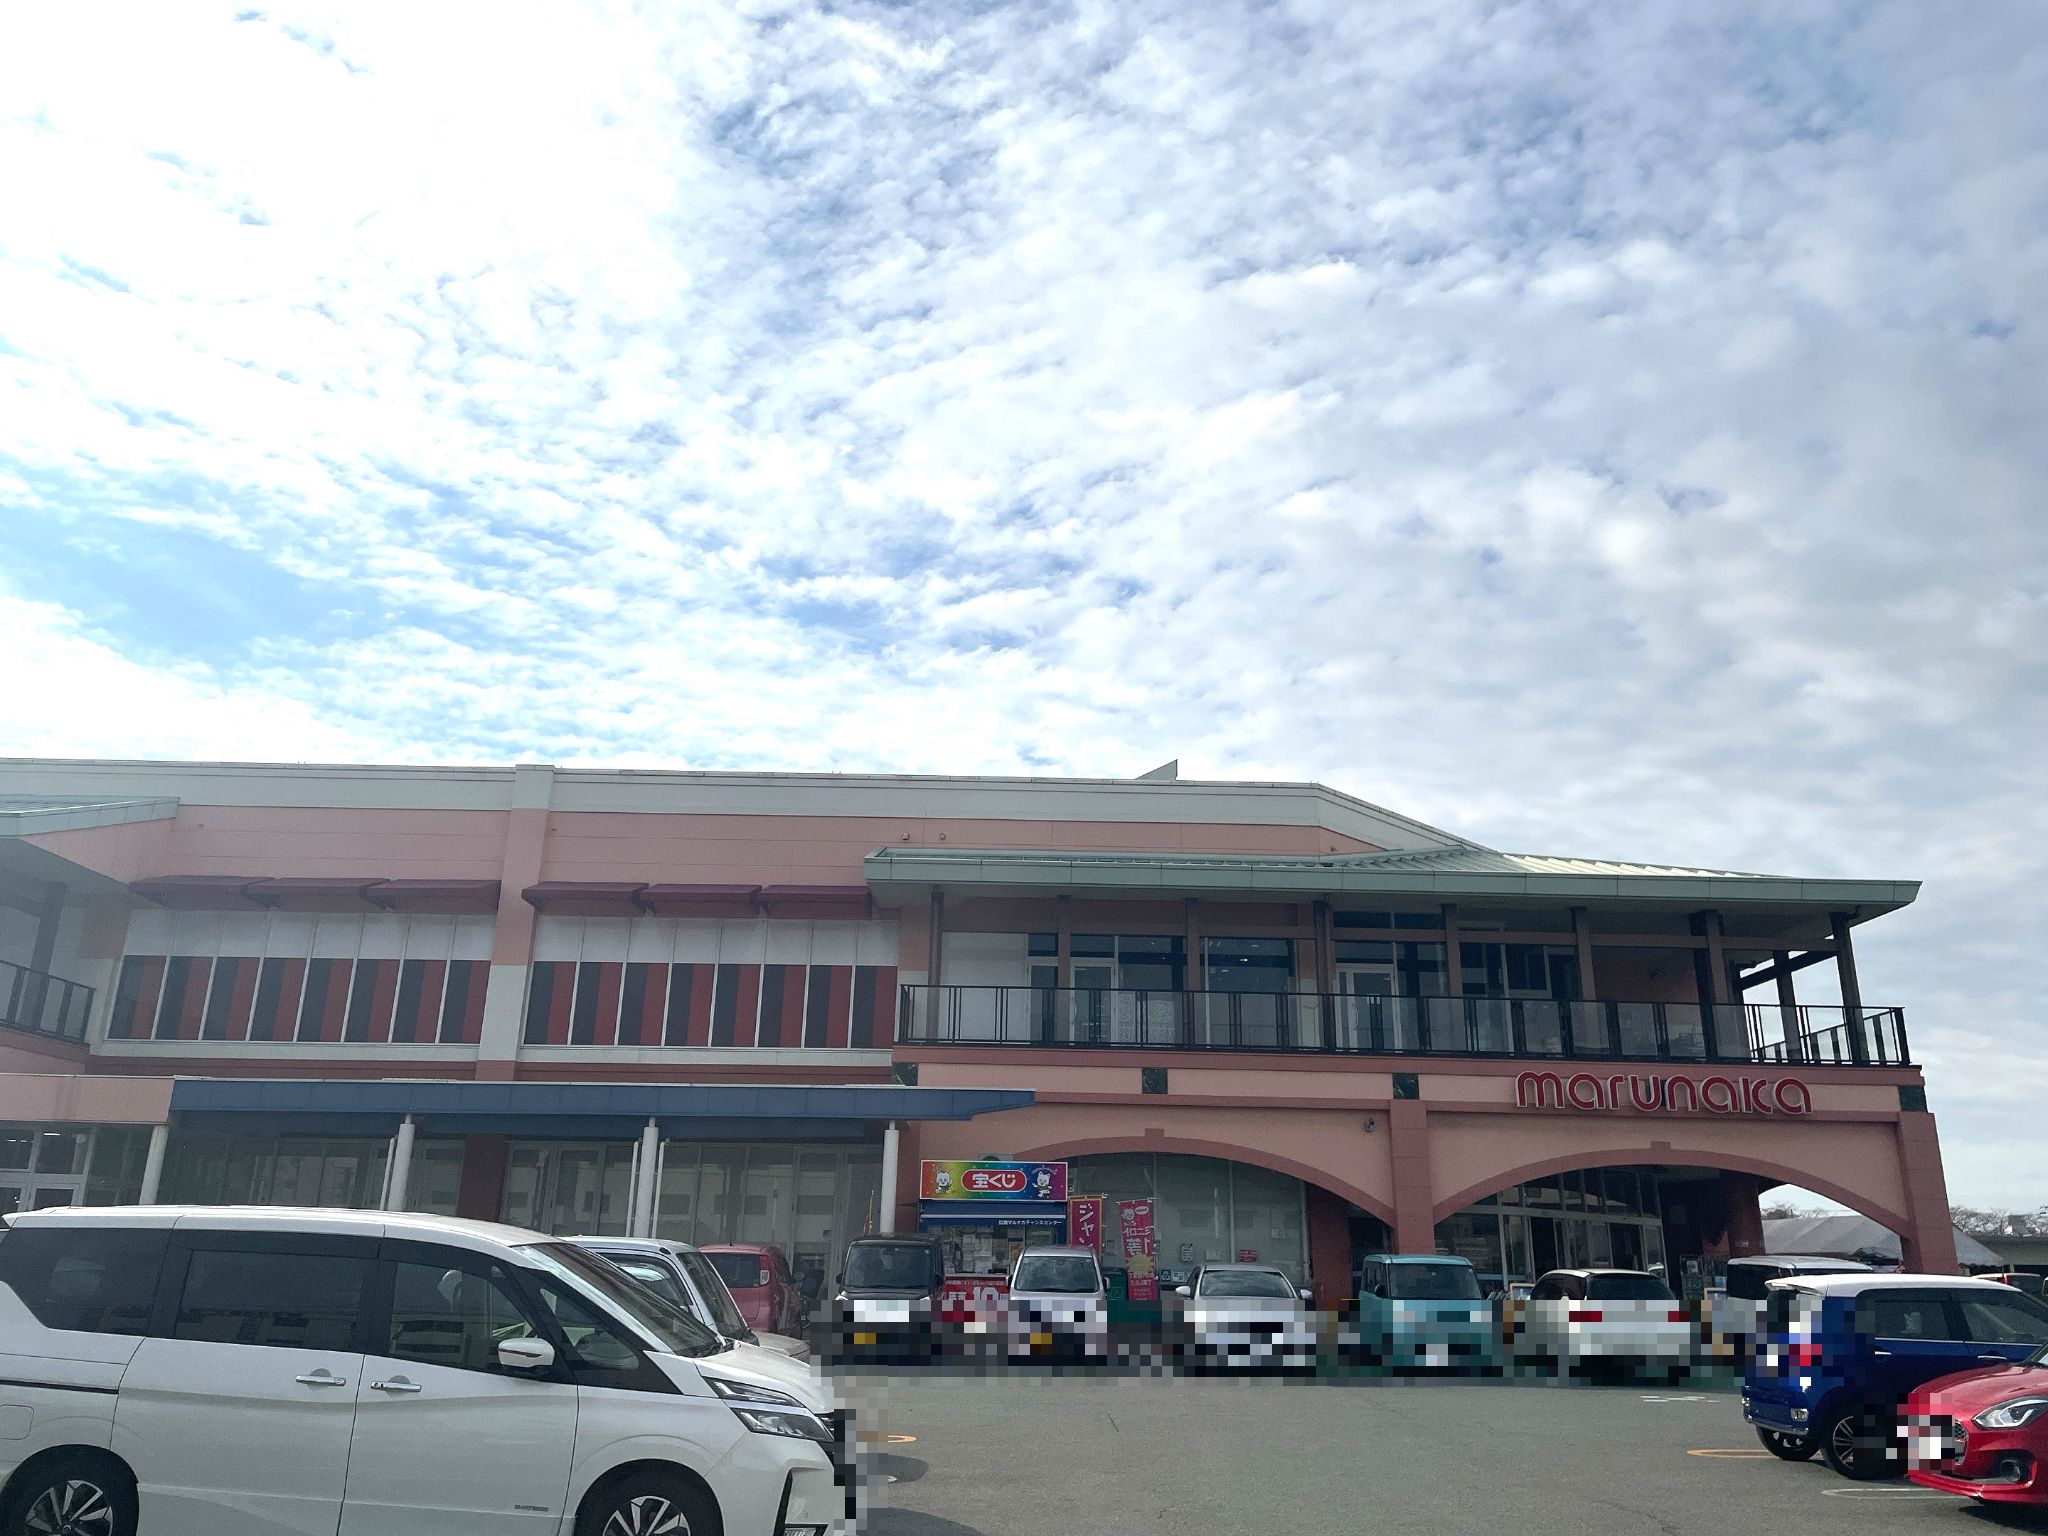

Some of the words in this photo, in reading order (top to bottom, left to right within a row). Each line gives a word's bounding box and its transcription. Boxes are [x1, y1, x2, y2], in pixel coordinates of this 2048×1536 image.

[1515, 1070, 1813, 1114] marunaka
[971, 1172, 1017, 1189] 宝くじ
